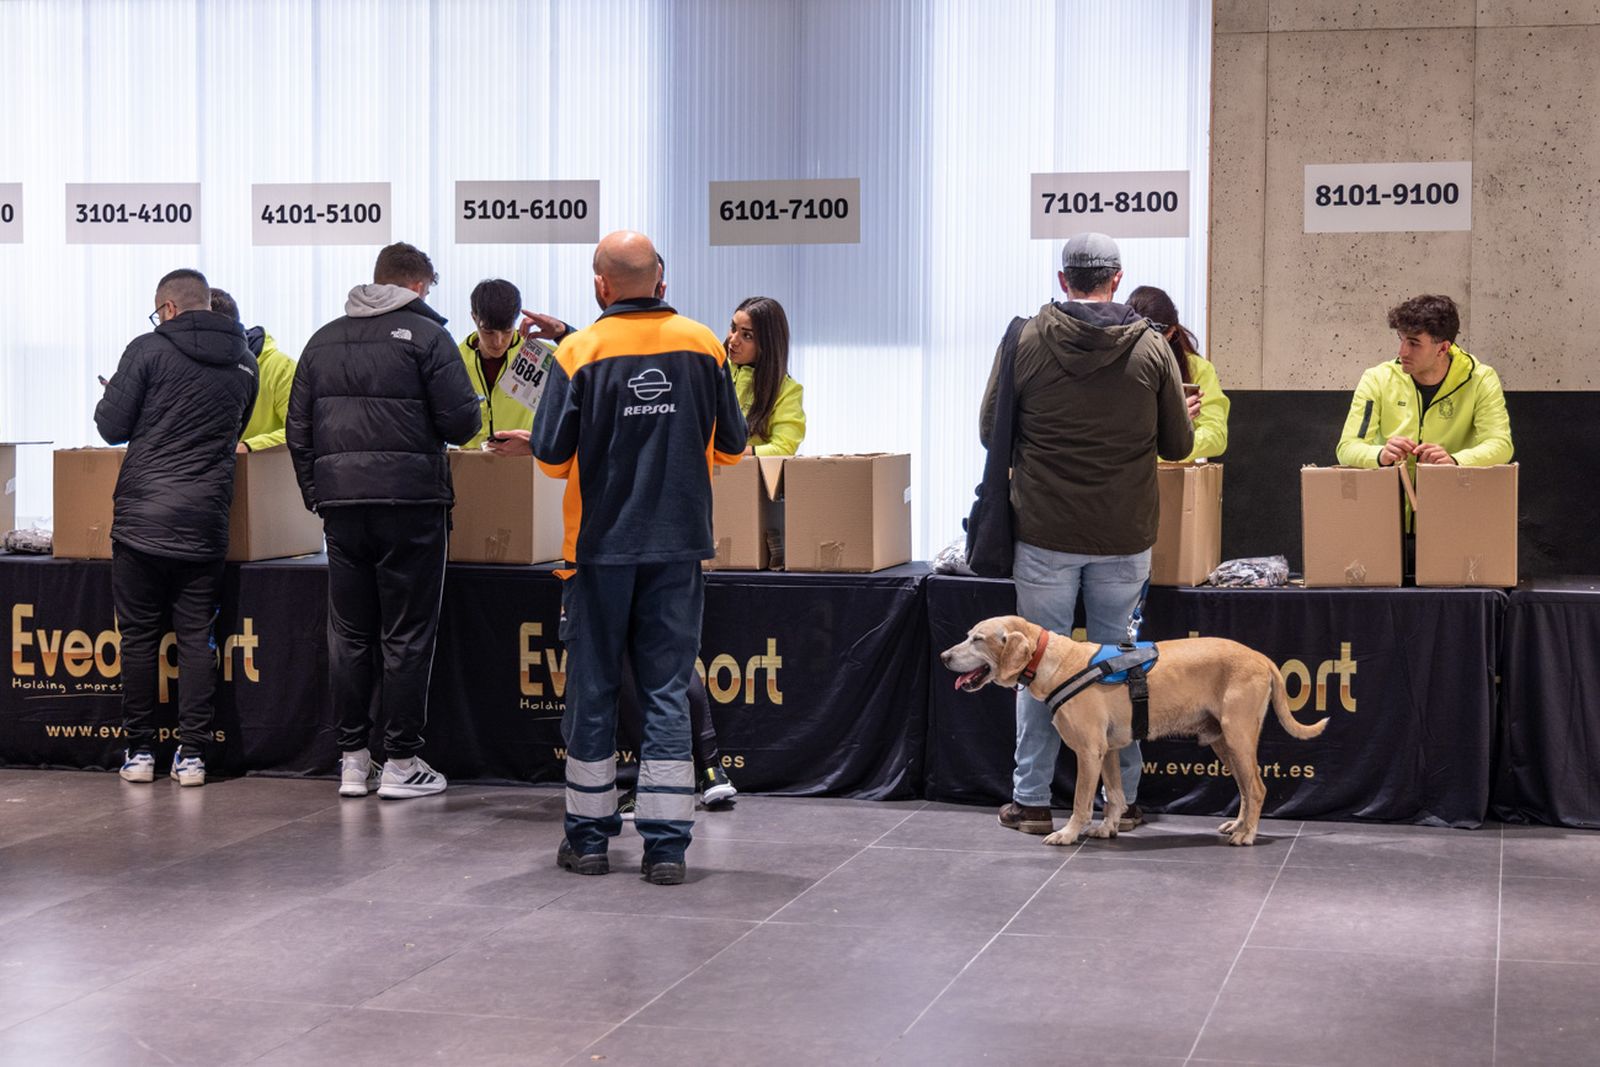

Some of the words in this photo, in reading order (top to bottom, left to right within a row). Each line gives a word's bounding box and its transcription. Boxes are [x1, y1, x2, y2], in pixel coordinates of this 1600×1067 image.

[1041, 190, 1178, 214] 7101-8100
[1315, 182, 1459, 207] 8101-9100
[75, 203, 192, 223] 3101-4100
[260, 202, 382, 224] 4101-5100
[463, 199, 588, 220] 5101-6100
[719, 198, 849, 221] 6101-7100
[623, 403, 677, 417] REPSOL
[12, 603, 260, 704] Evedprt
[12, 677, 66, 694] Holding
[520, 698, 567, 711] Holdin
